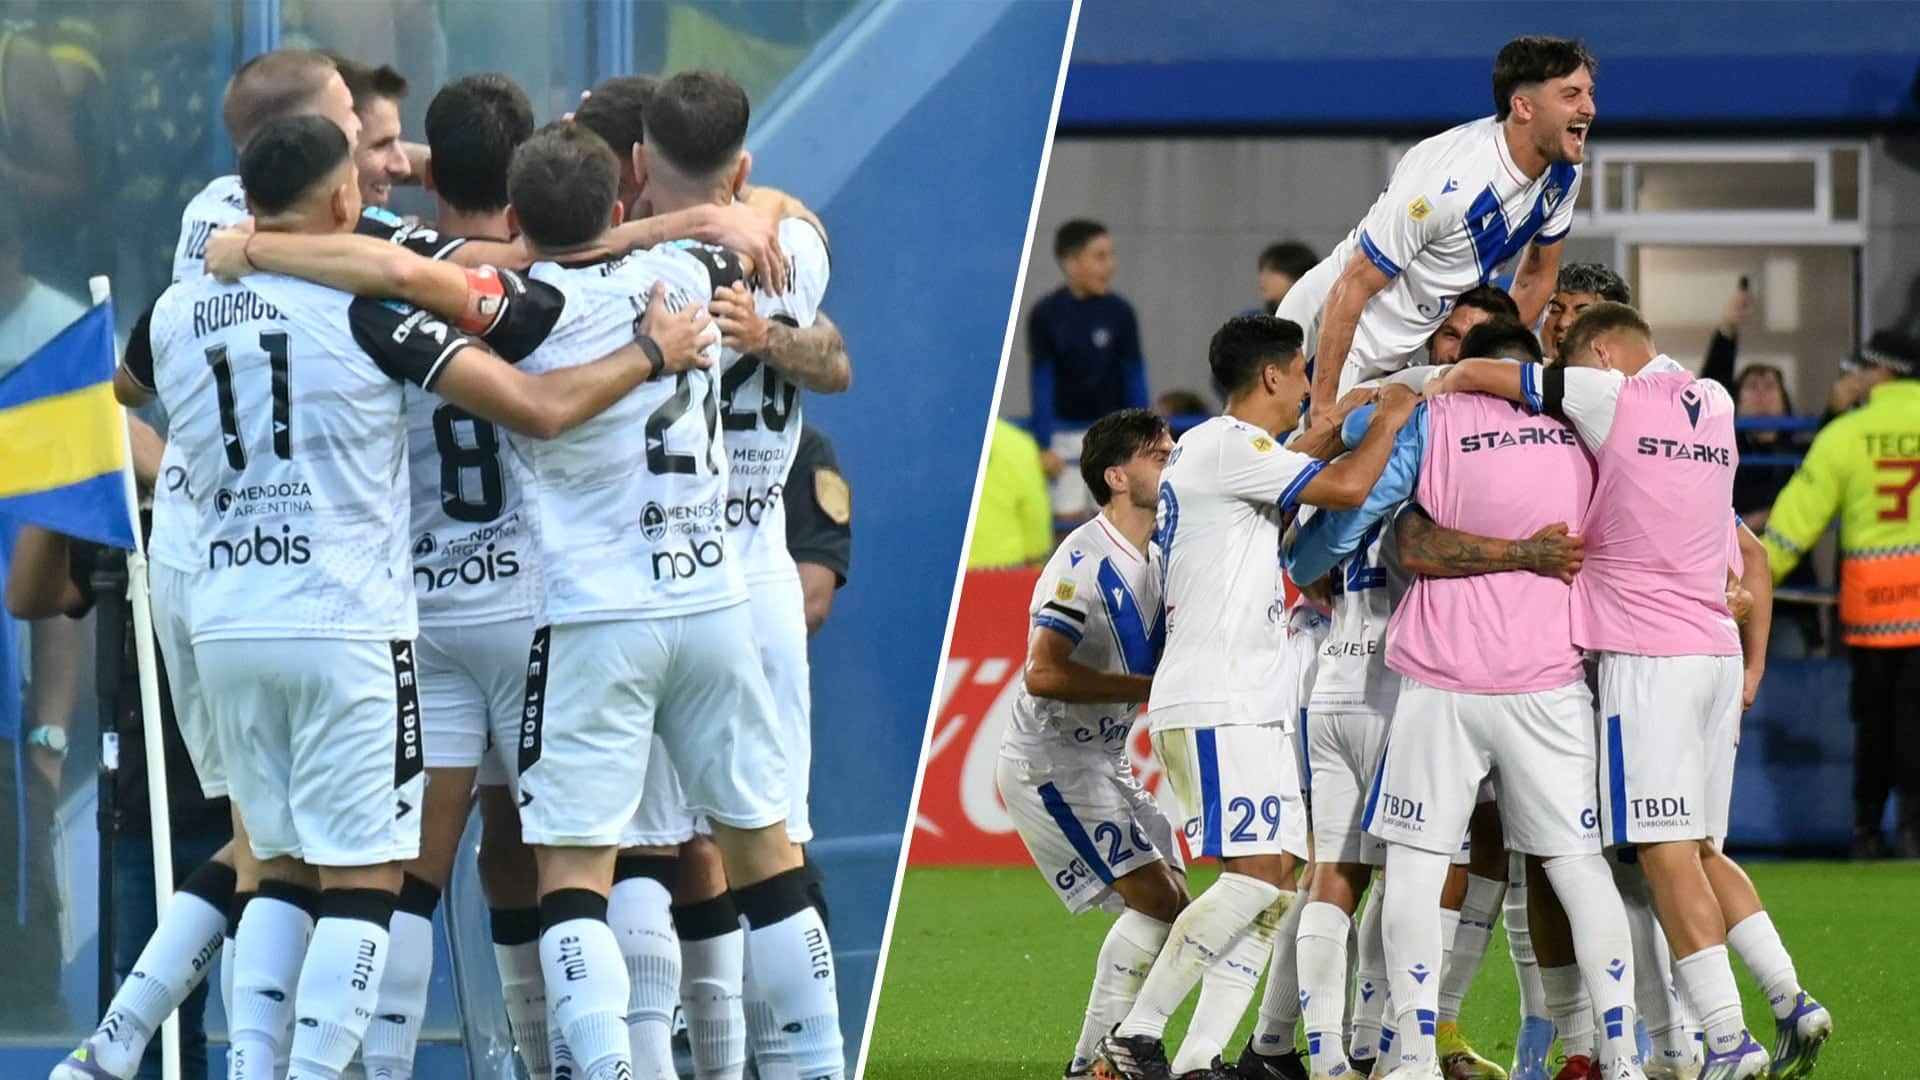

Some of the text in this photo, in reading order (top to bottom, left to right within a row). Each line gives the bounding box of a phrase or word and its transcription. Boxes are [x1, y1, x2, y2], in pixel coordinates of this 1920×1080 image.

[204, 329, 294, 471] 11
[433, 401, 507, 523] 8
[1461, 427, 1576, 453] STARKE
[1637, 436, 1730, 467] STARKE
[234, 482, 312, 502] MENDOZA
[234, 500, 313, 518] ARGENTINA
[209, 524, 311, 570] nobis
[396, 647, 418, 760] YE 1908
[522, 692, 540, 749] 1908
[1228, 795, 1282, 843] 29
[1383, 793, 1426, 822] TBDL
[1630, 796, 1691, 820] TBDL
[351, 938, 378, 992] mitre
[556, 935, 588, 982] mitre
[804, 927, 831, 980] mitre
